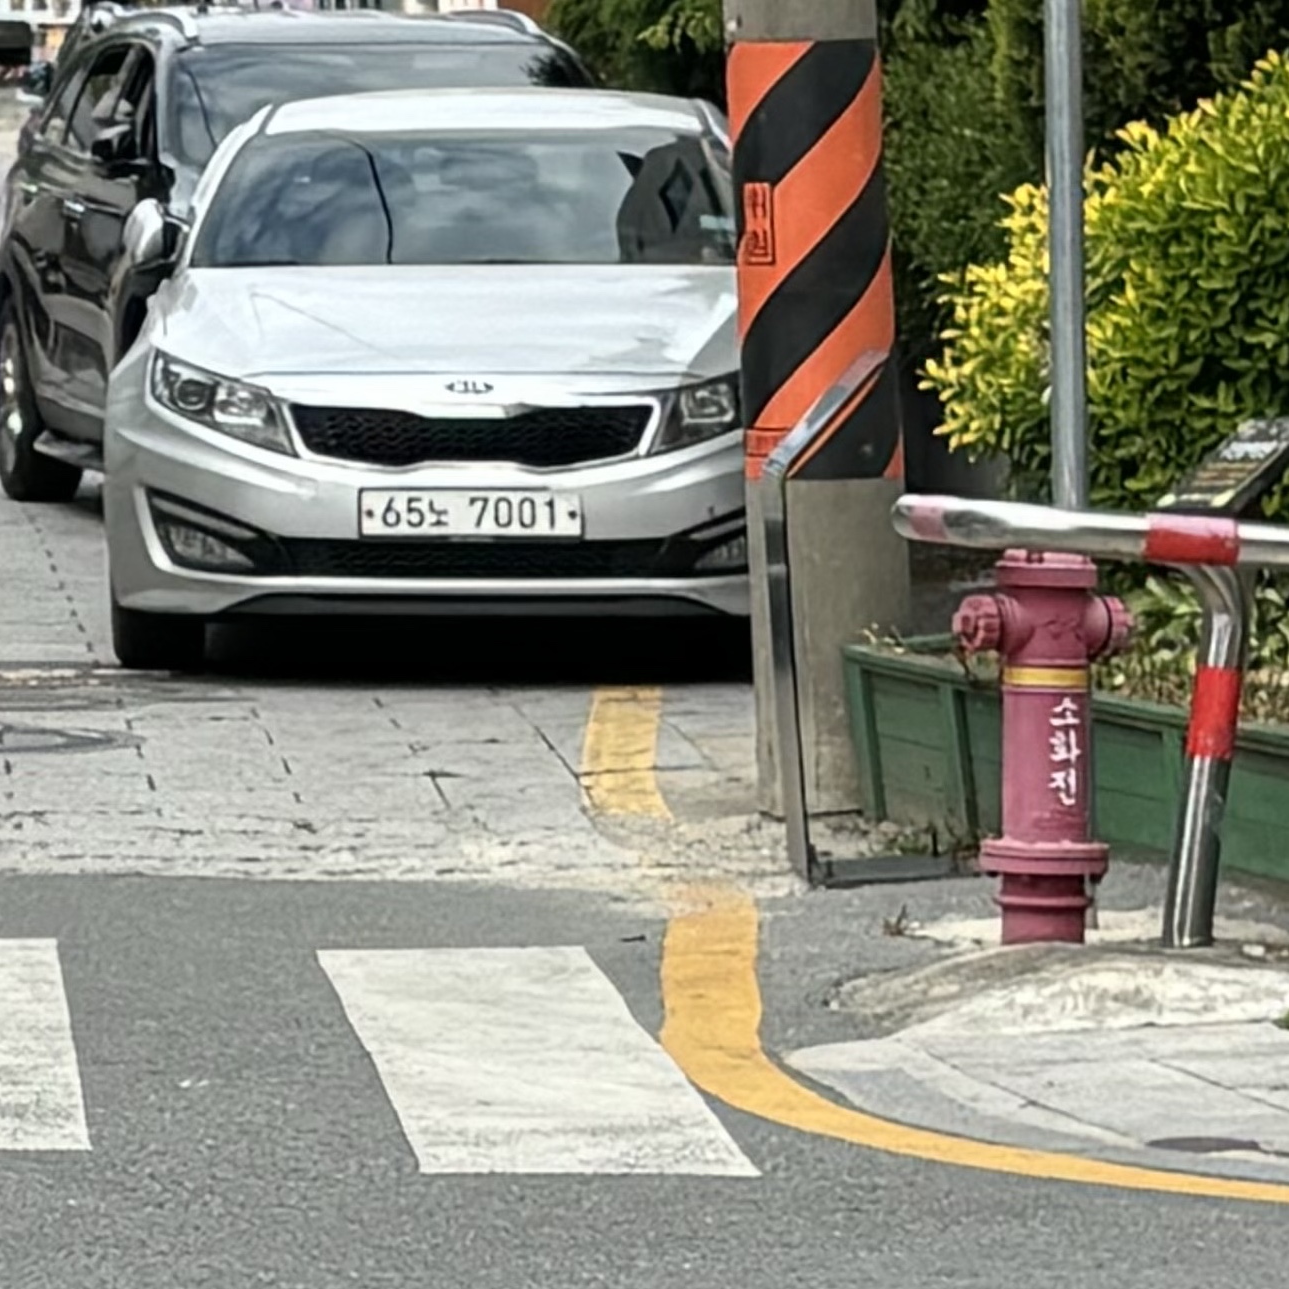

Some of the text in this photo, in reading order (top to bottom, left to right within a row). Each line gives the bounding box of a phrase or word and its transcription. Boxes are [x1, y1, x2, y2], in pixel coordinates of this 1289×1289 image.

[381, 496, 556, 530] 65노 7001
[1048, 697, 1082, 805] 소화전
